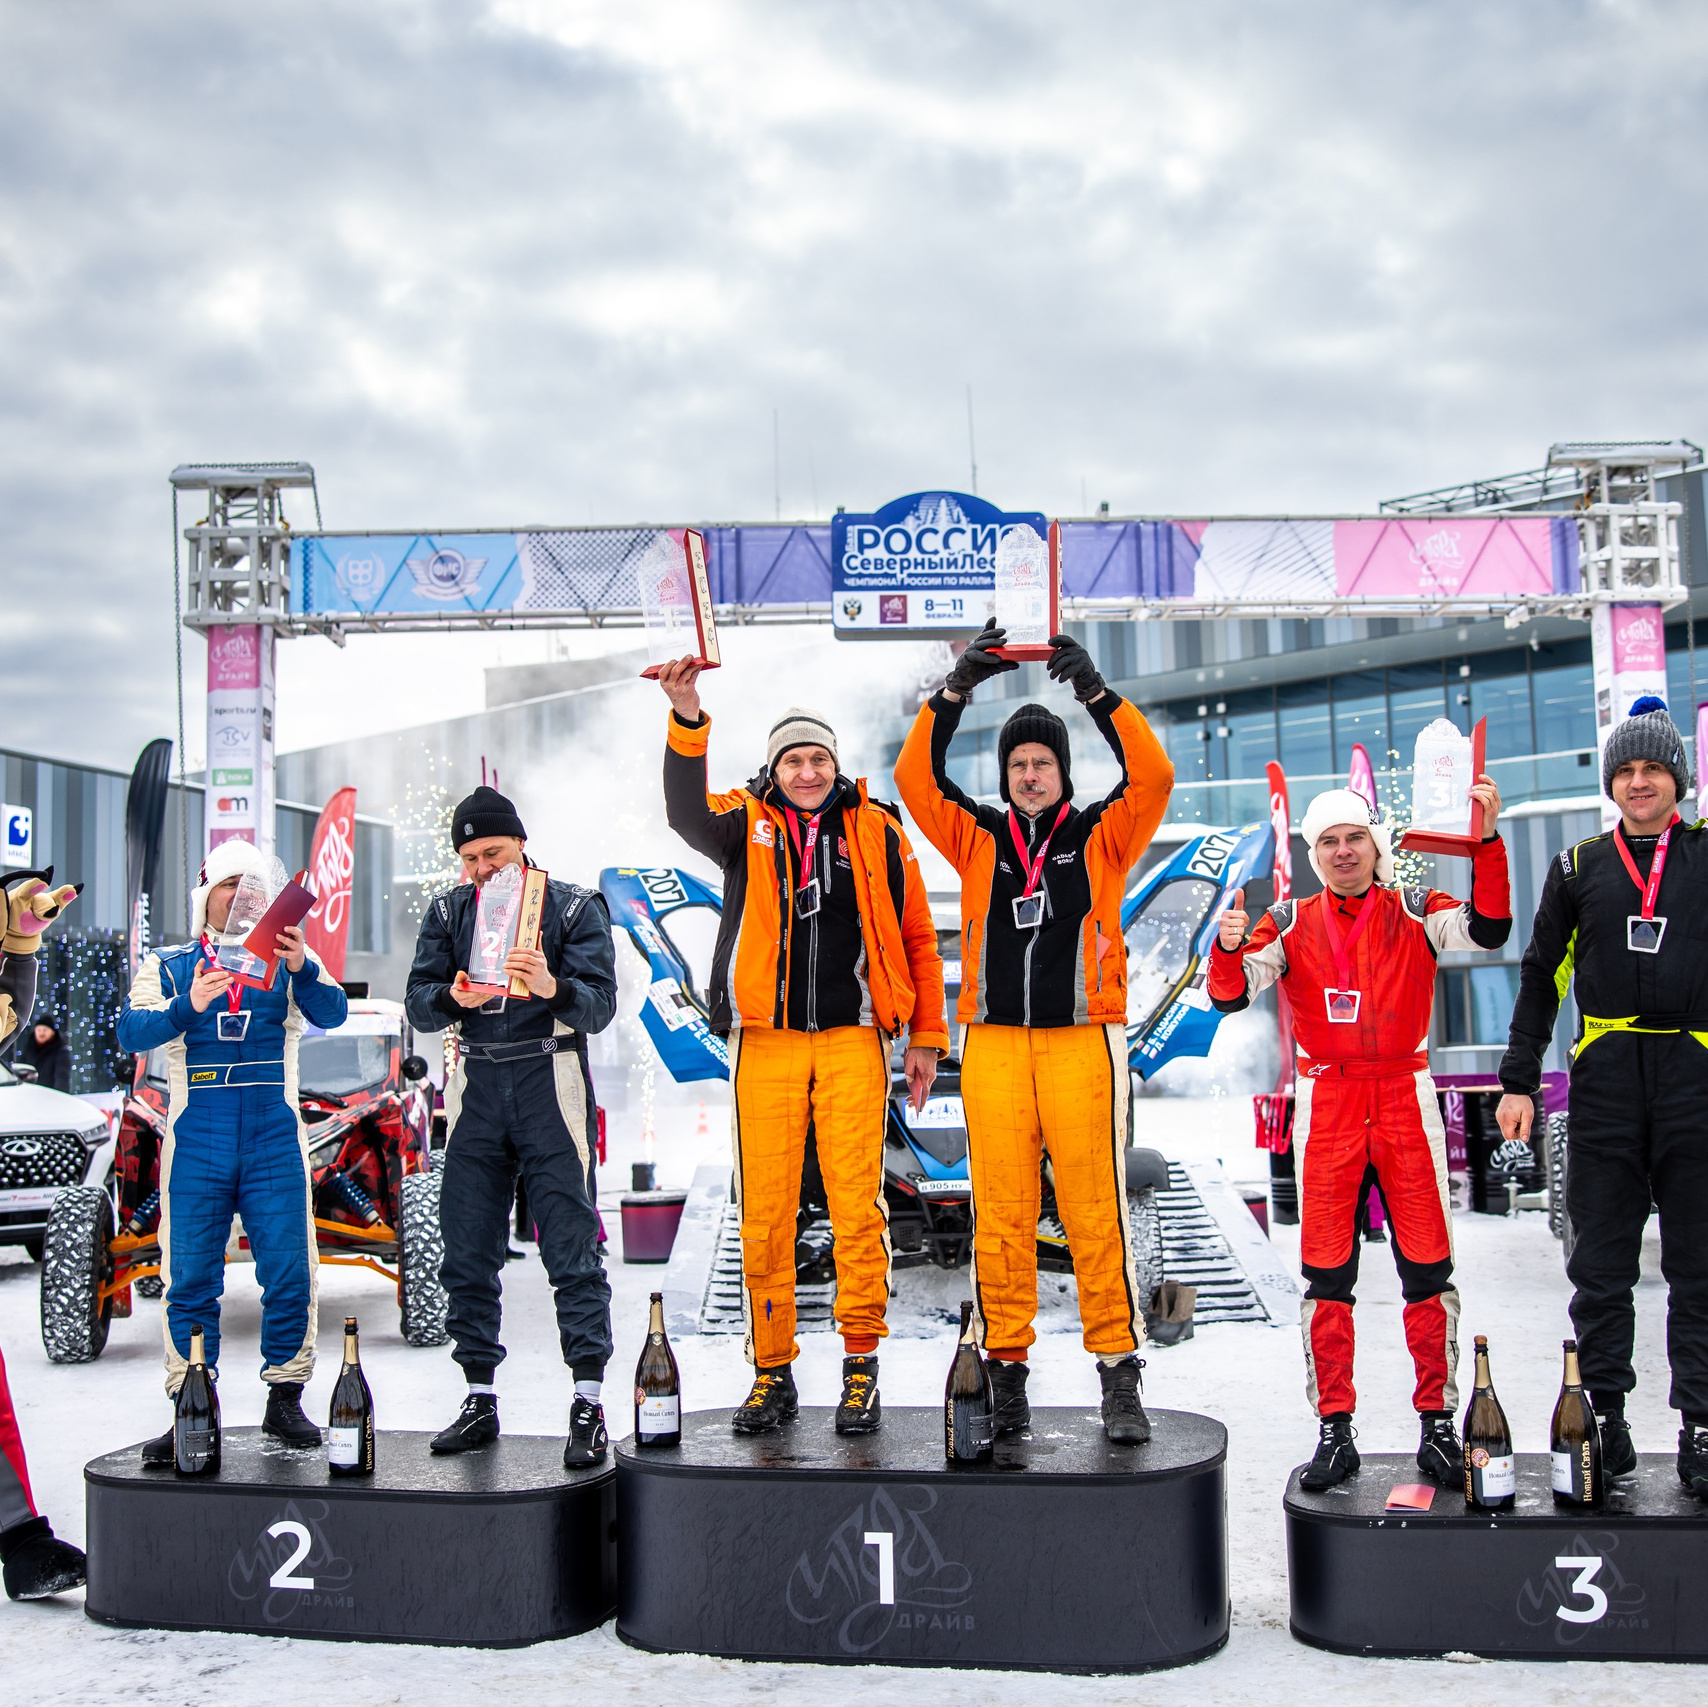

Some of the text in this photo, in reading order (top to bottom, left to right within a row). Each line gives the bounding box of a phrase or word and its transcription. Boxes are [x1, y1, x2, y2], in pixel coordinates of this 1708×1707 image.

[857, 527, 1013, 556] РОССИ
[1427, 781, 1451, 808] 3
[1191, 834, 1235, 876] 207
[641, 868, 687, 904] 207
[481, 931, 500, 958] 2
[1153, 1002, 1180, 1036] ГАДАСИН
[1160, 1004, 1190, 1041] КОЖУХОВ
[1584, 1470, 1592, 1502] Новый
[267, 1521, 314, 1590] 2
[864, 1532, 894, 1604] 1
[302, 1593, 355, 1608] ДРАЙВ
[1555, 1556, 1608, 1623] 3
[897, 1611, 976, 1630] ДРАЙВ
